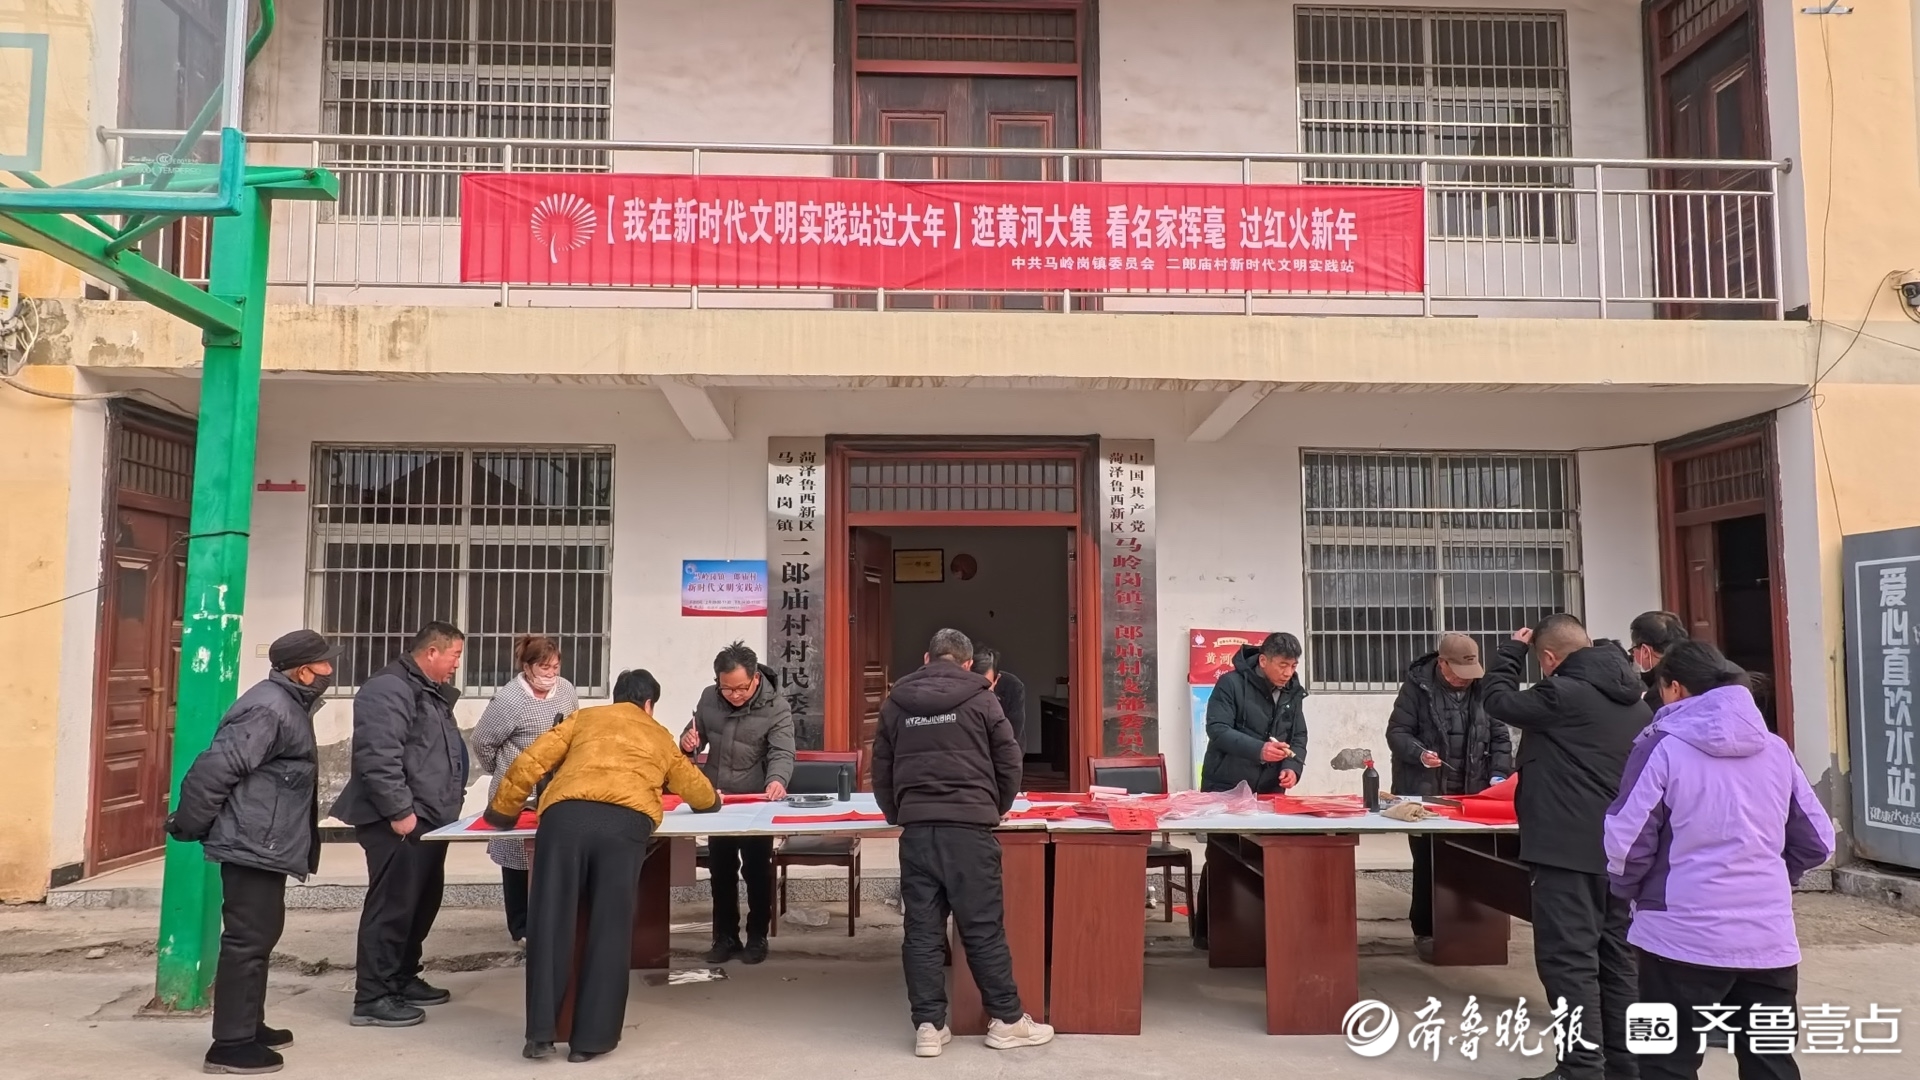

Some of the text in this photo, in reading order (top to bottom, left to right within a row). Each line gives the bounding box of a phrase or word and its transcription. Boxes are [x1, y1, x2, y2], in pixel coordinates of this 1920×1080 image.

[1011, 256, 1355, 273] 中共马岭岗镇委员会 二郎庙村新时代文明实践站
[1106, 204, 1227, 250] 看名家挥毫
[1239, 206, 1358, 251] 过红火新年
[776, 451, 794, 532] 马岭岗镇
[798, 451, 817, 532] 菏泽鲁西新区
[1109, 452, 1125, 534] 菏泽鲁西新区
[1129, 452, 1146, 533] 中国共产党
[688, 582, 763, 593] 新时代文明实践站
[1205, 651, 1235, 668] 黄河
[1879, 566, 1916, 808] 爱心直饮水站
